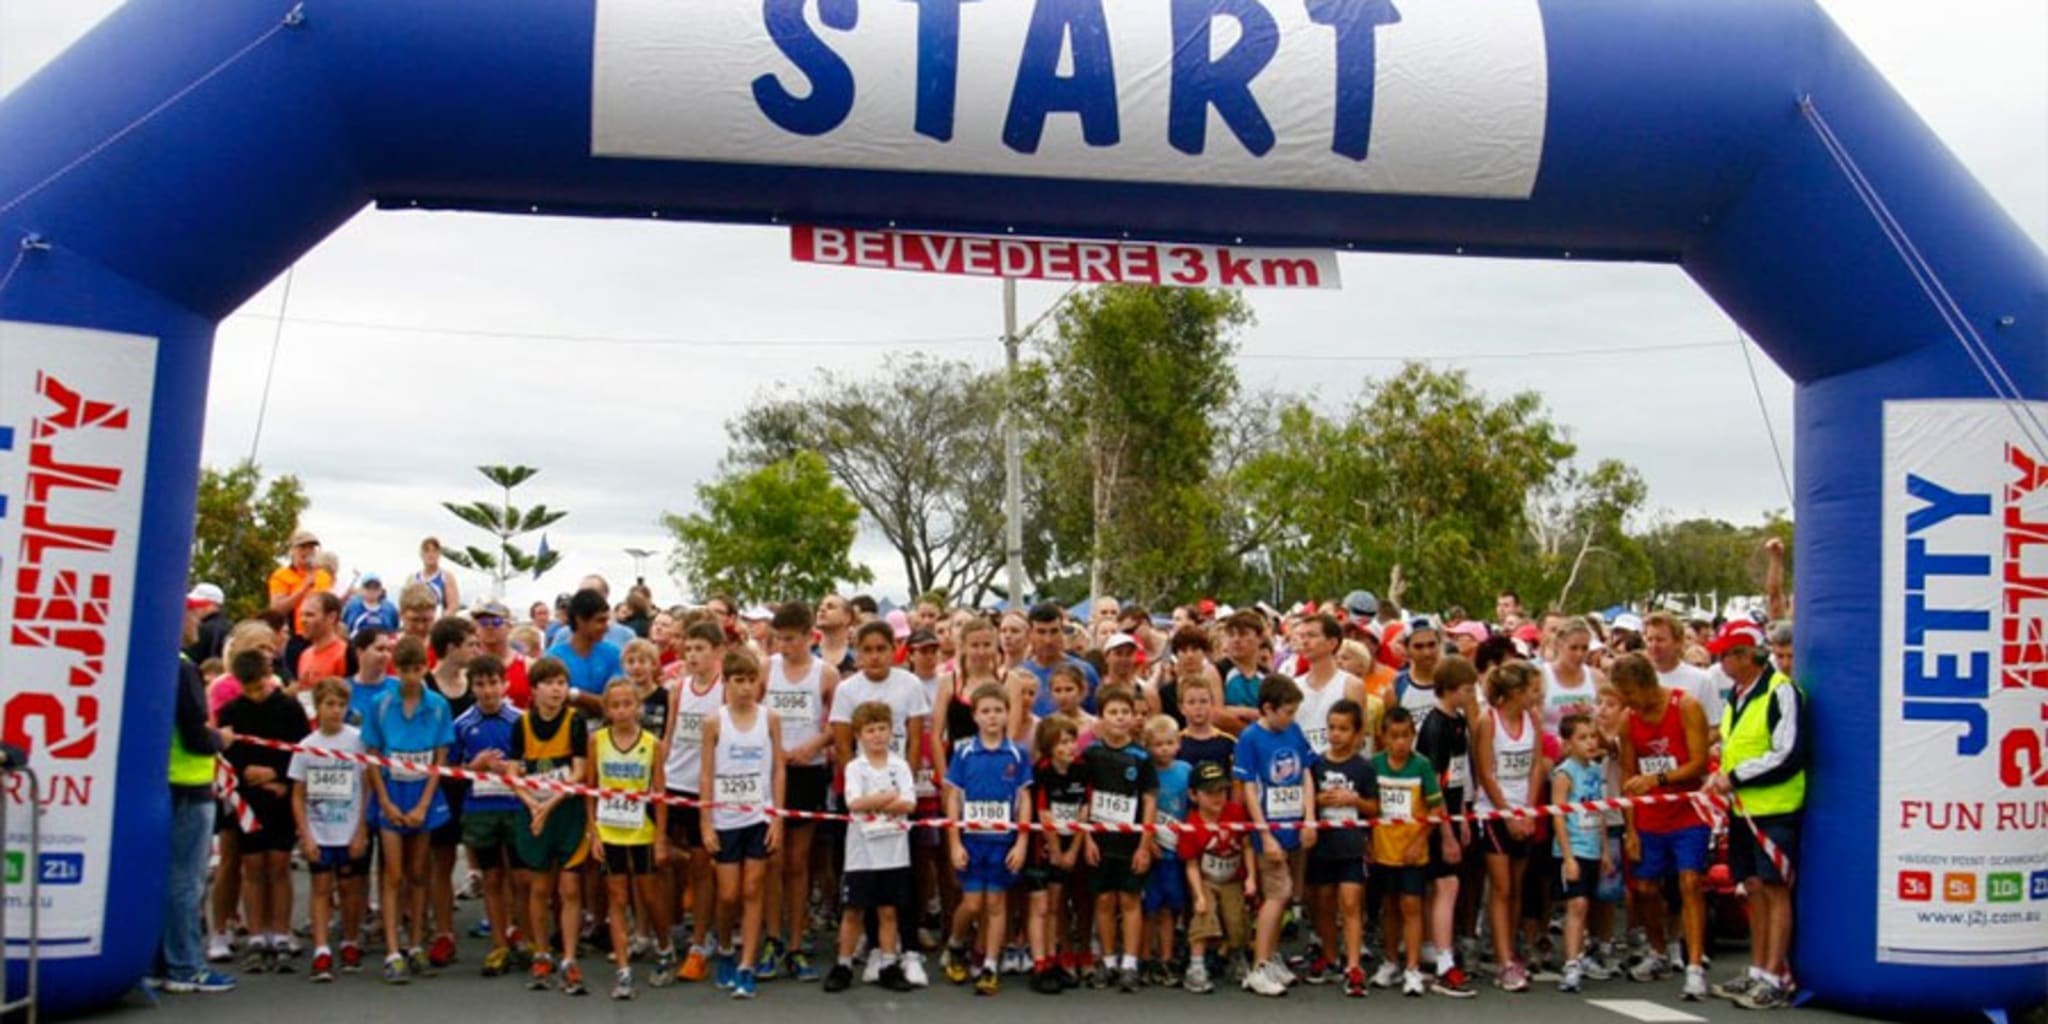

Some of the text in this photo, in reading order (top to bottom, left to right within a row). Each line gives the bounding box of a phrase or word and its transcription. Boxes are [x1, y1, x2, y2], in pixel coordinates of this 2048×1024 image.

[751, 0, 1401, 161] START
[812, 227, 1320, 286] BELVEDERE 3 km
[1902, 472, 1992, 756] JETTY
[968, 803, 1004, 818] 3180
[1096, 796, 1130, 812] 3163
[1901, 801, 1984, 831] FUN
